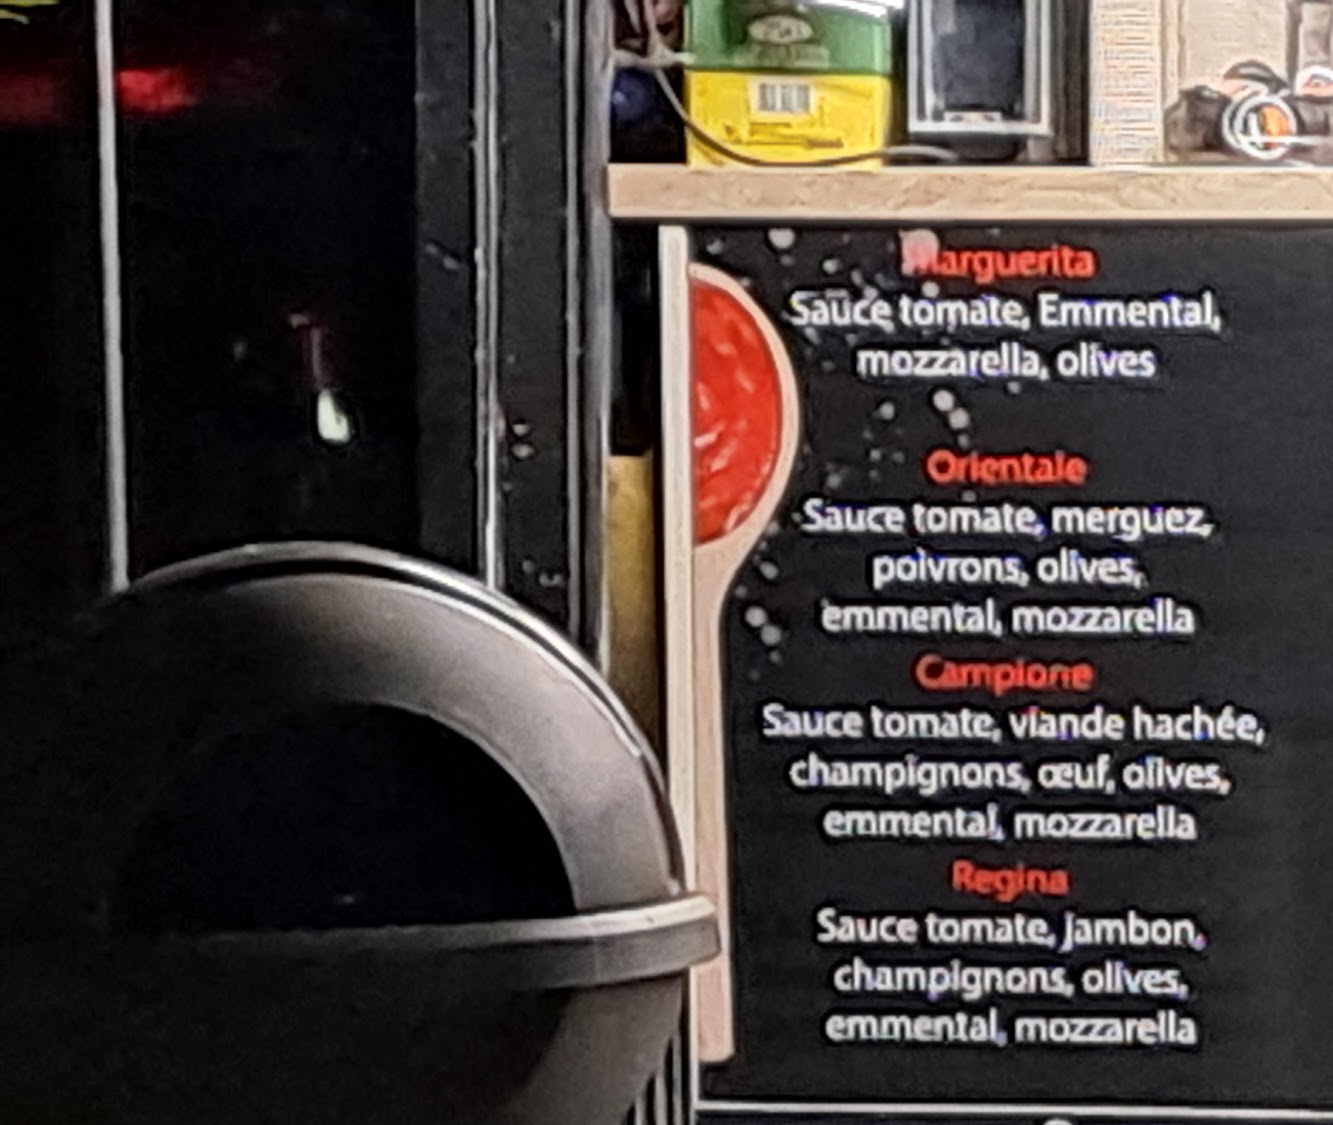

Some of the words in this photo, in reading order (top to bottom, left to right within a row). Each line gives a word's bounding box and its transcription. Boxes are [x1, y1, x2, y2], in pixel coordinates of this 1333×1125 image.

[790, 291, 894, 330] Sauce
[899, 291, 1031, 330] tomate,
[1038, 291, 1221, 330] Emmental,
[857, 343, 1049, 378] mozzarella,
[1057, 343, 1156, 378] olives
[927, 450, 1087, 484] Orientale
[803, 499, 905, 534] Sauce
[913, 502, 1045, 538] tomate,
[1052, 506, 1213, 540] merguez,
[873, 548, 1030, 588] poivrons,
[1037, 548, 1143, 588] olives,
[916, 655, 1094, 694] Campione
[763, 702, 863, 739] Sauce
[871, 705, 1001, 743] tomate,
[1009, 704, 1125, 741] viande
[1133, 704, 1265, 745] hachée,
[789, 754, 1031, 794] champignons,
[1123, 755, 1231, 794] olives,
[953, 860, 1070, 901] Regina
[818, 908, 918, 943] Sauce
[925, 912, 1056, 948] tomate,
[1061, 909, 1205, 950] jambon,
[834, 958, 1074, 999] champignons,
[1082, 960, 1188, 999] olives,
